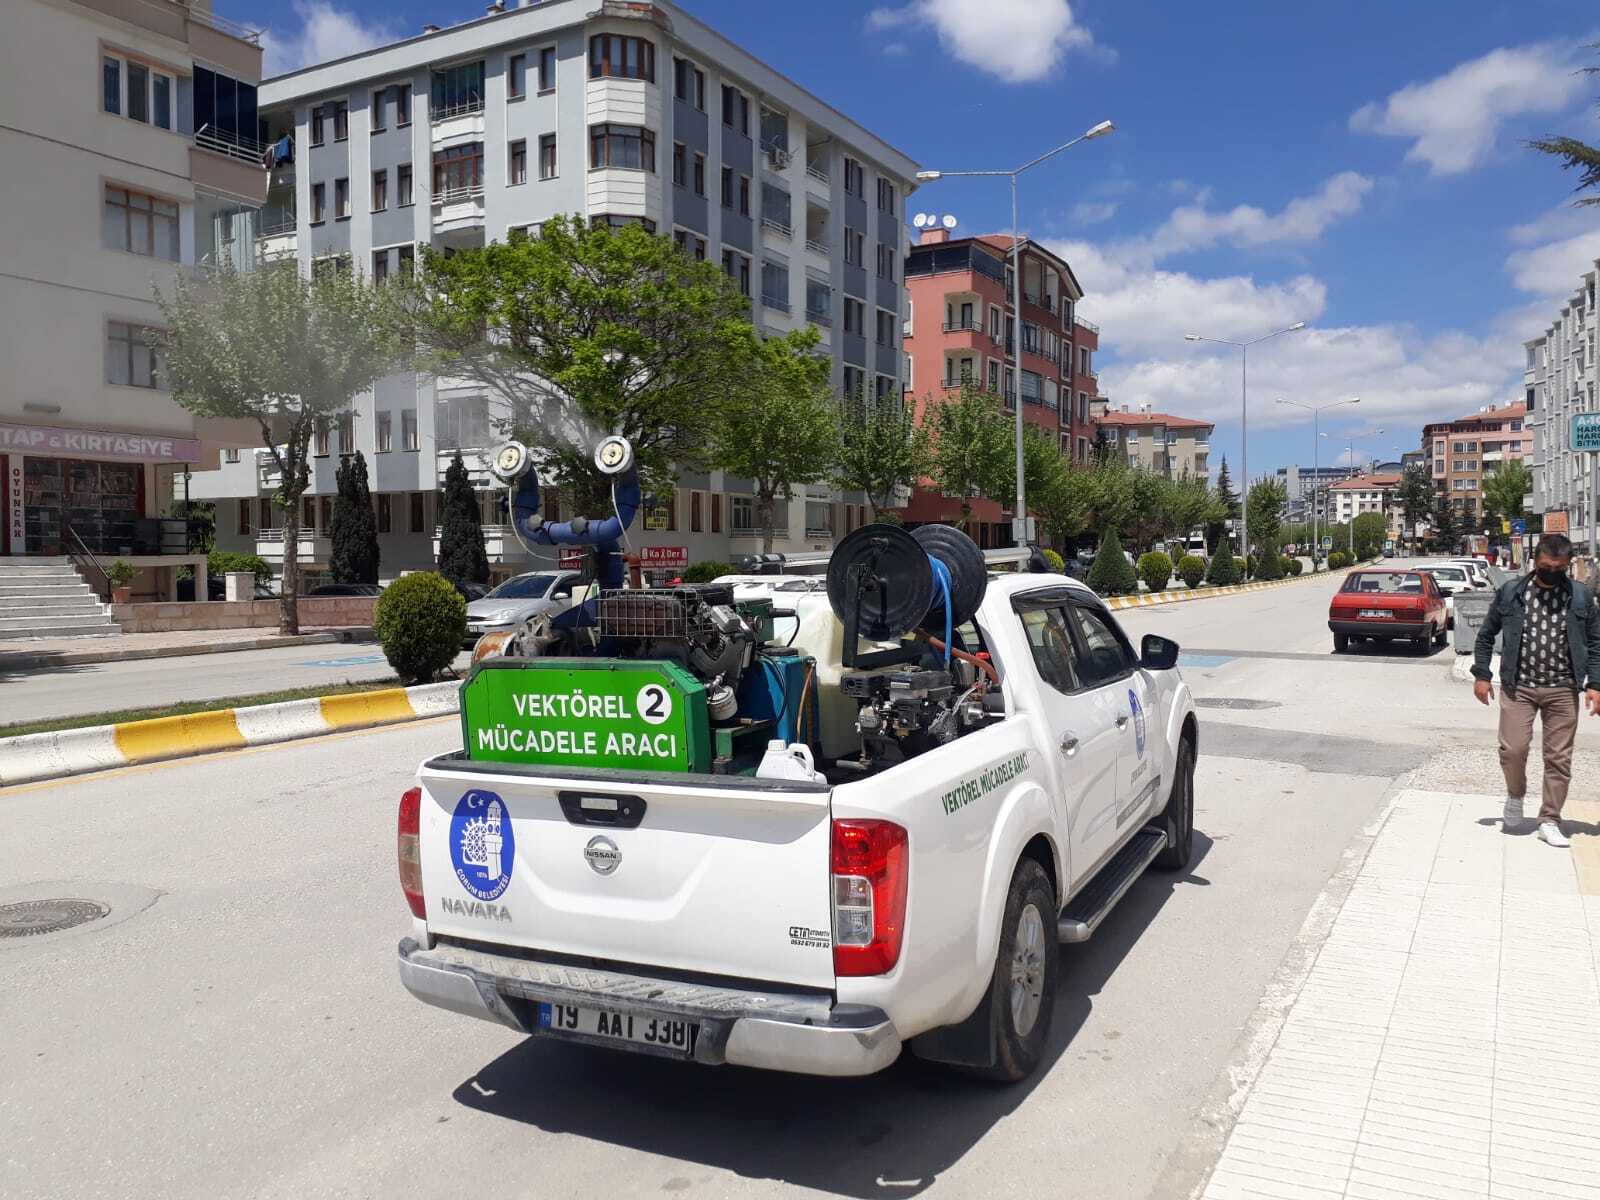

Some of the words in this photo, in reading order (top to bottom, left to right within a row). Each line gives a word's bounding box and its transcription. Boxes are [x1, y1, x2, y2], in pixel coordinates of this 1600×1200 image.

[50, 435, 61, 448] &
[512, 689, 632, 719] VEKTÖREL
[645, 687, 665, 718] 2
[478, 724, 597, 755] MÜCADELE
[604, 732, 676, 758] ARACI
[941, 779, 982, 816] VEKTÖREL
[586, 850, 617, 860] NISSAN
[442, 897, 512, 922] NAVARA
[555, 1003, 579, 1029] 19
